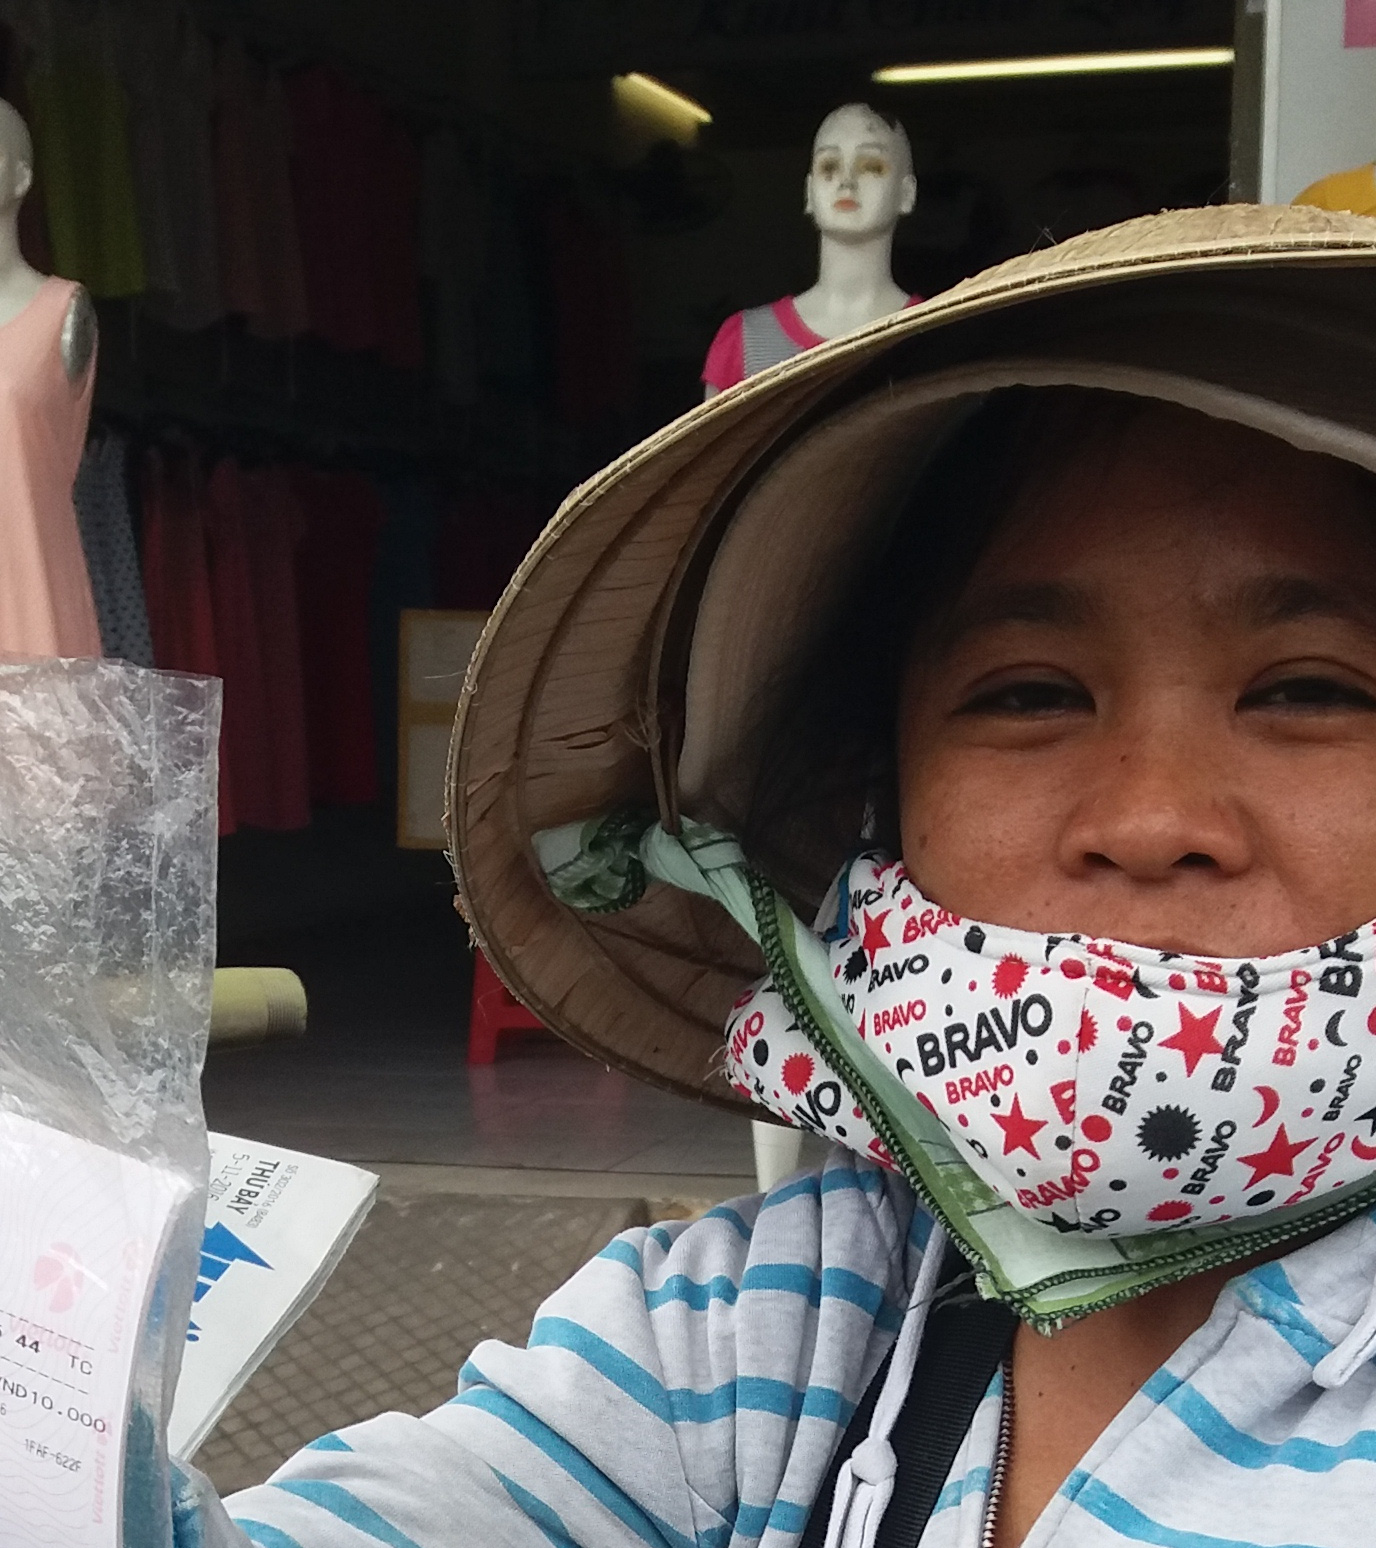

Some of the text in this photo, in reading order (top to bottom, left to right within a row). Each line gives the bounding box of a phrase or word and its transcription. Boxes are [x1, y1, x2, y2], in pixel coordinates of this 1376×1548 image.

[872, 998, 928, 1036] BRAVO
[916, 992, 1053, 1078] BRAVO
[1211, 963, 1260, 1092] BRAVO
[1272, 969, 1313, 1067] BRAVO
[945, 1063, 1015, 1105] BRAVO
[1102, 1020, 1155, 1116] BRAVO
[1322, 1054, 1362, 1121] BRAVO
[226, 1160, 279, 1215] THỨ BẢY
[1181, 1119, 1238, 1195] BRAVO
[15, 1334, 41, 1354] 44
[68, 1355, 93, 1375] TC
